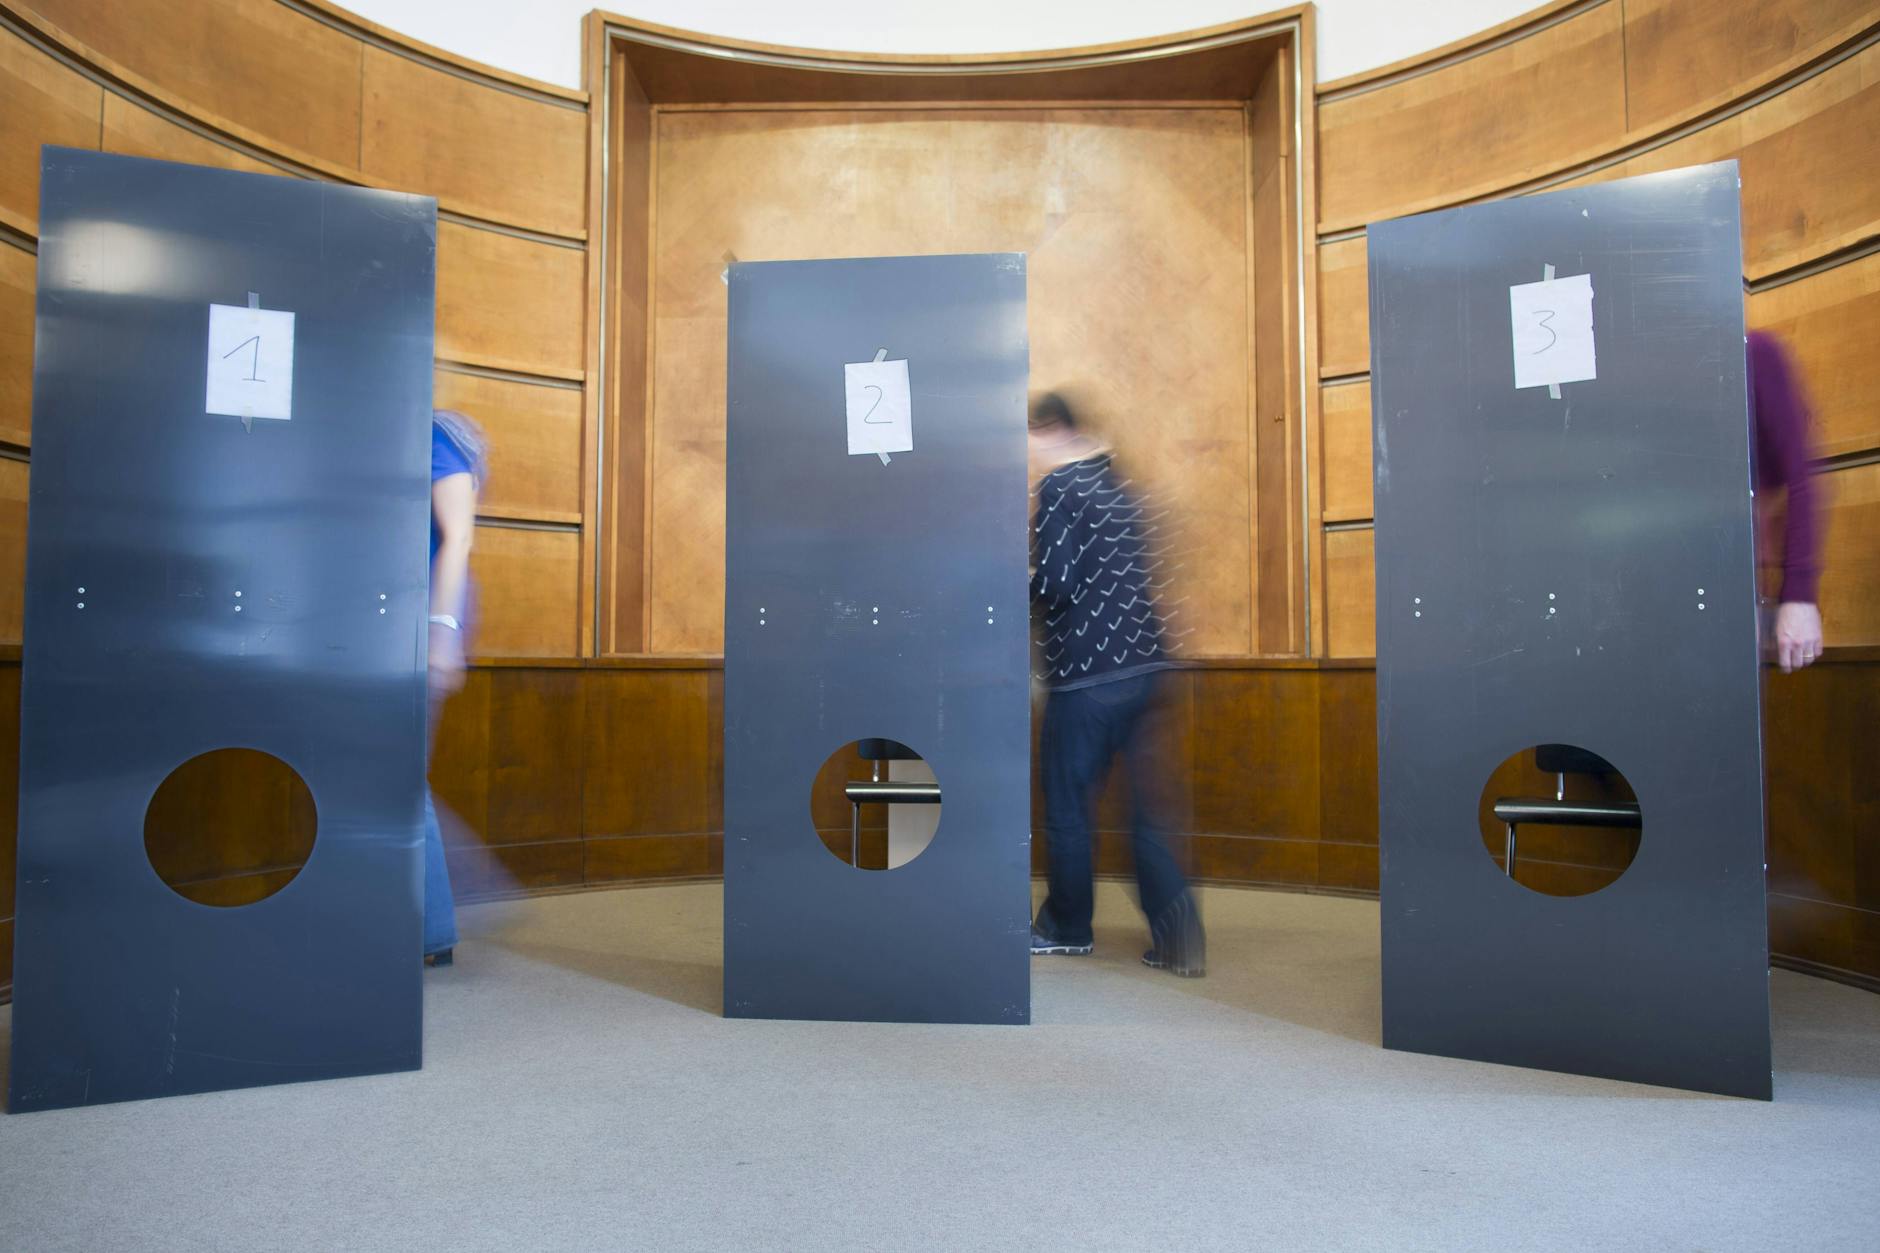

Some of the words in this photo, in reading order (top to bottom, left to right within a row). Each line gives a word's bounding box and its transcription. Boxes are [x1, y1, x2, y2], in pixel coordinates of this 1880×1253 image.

[1531, 309, 1557, 356] 3
[223, 335, 267, 383] 1
[863, 384, 894, 425] 2
